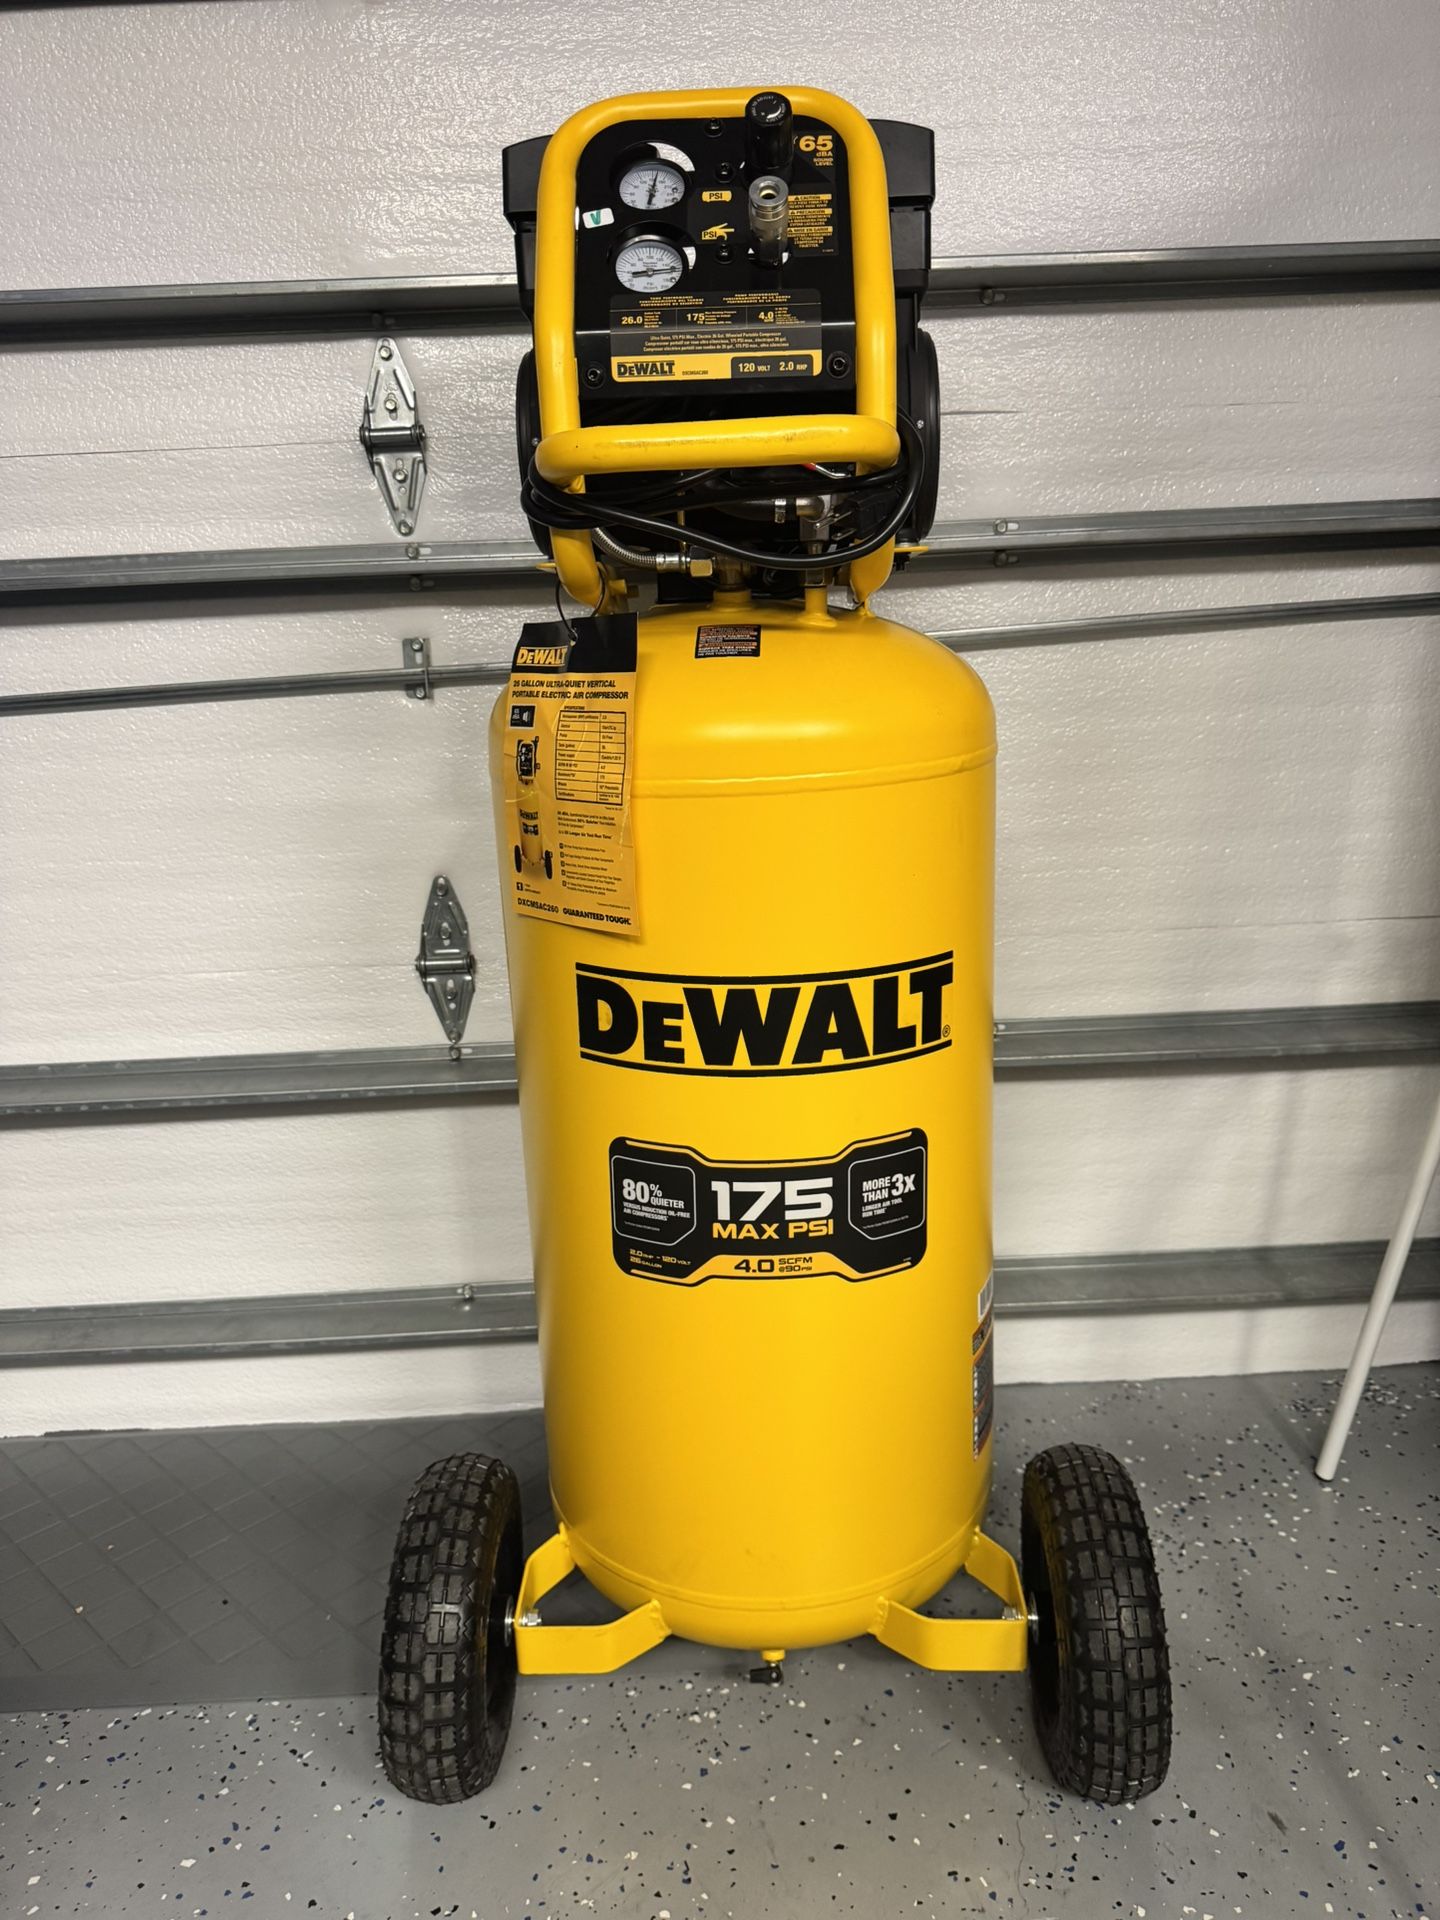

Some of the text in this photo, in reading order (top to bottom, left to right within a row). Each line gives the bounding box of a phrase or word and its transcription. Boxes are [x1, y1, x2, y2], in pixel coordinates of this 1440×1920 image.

[800, 135, 833, 152] 65
[622, 316, 642, 326] 26.0
[686, 313, 704, 322] 175
[758, 311, 774, 320] 4.0
[617, 361, 675, 376] DEWALT
[738, 363, 755, 372] 120
[779, 361, 793, 370] 2.0
[516, 646, 568, 666] DEWALT
[520, 680, 545, 688] GALLON
[586, 680, 616, 688] VERTICAL
[541, 690, 571, 699] ELECTRIC
[585, 691, 629, 699] COMPRESSOR
[563, 908, 604, 921] GUARANTEED
[863, 1176, 891, 1192] MORE
[650, 1196, 684, 1209] QUIETER
[711, 1177, 833, 1221] 175
[862, 1188, 888, 1203] THAN
[623, 1202, 690, 1218] VERSUS INDUCTION OIL-FREE
[862, 1203, 881, 1212] LONGER
[891, 1197, 903, 1205] TOOL
[712, 1218, 834, 1239] MAX PSI
[734, 1259, 774, 1273] 4.0
[778, 1256, 813, 1265] SCFM
